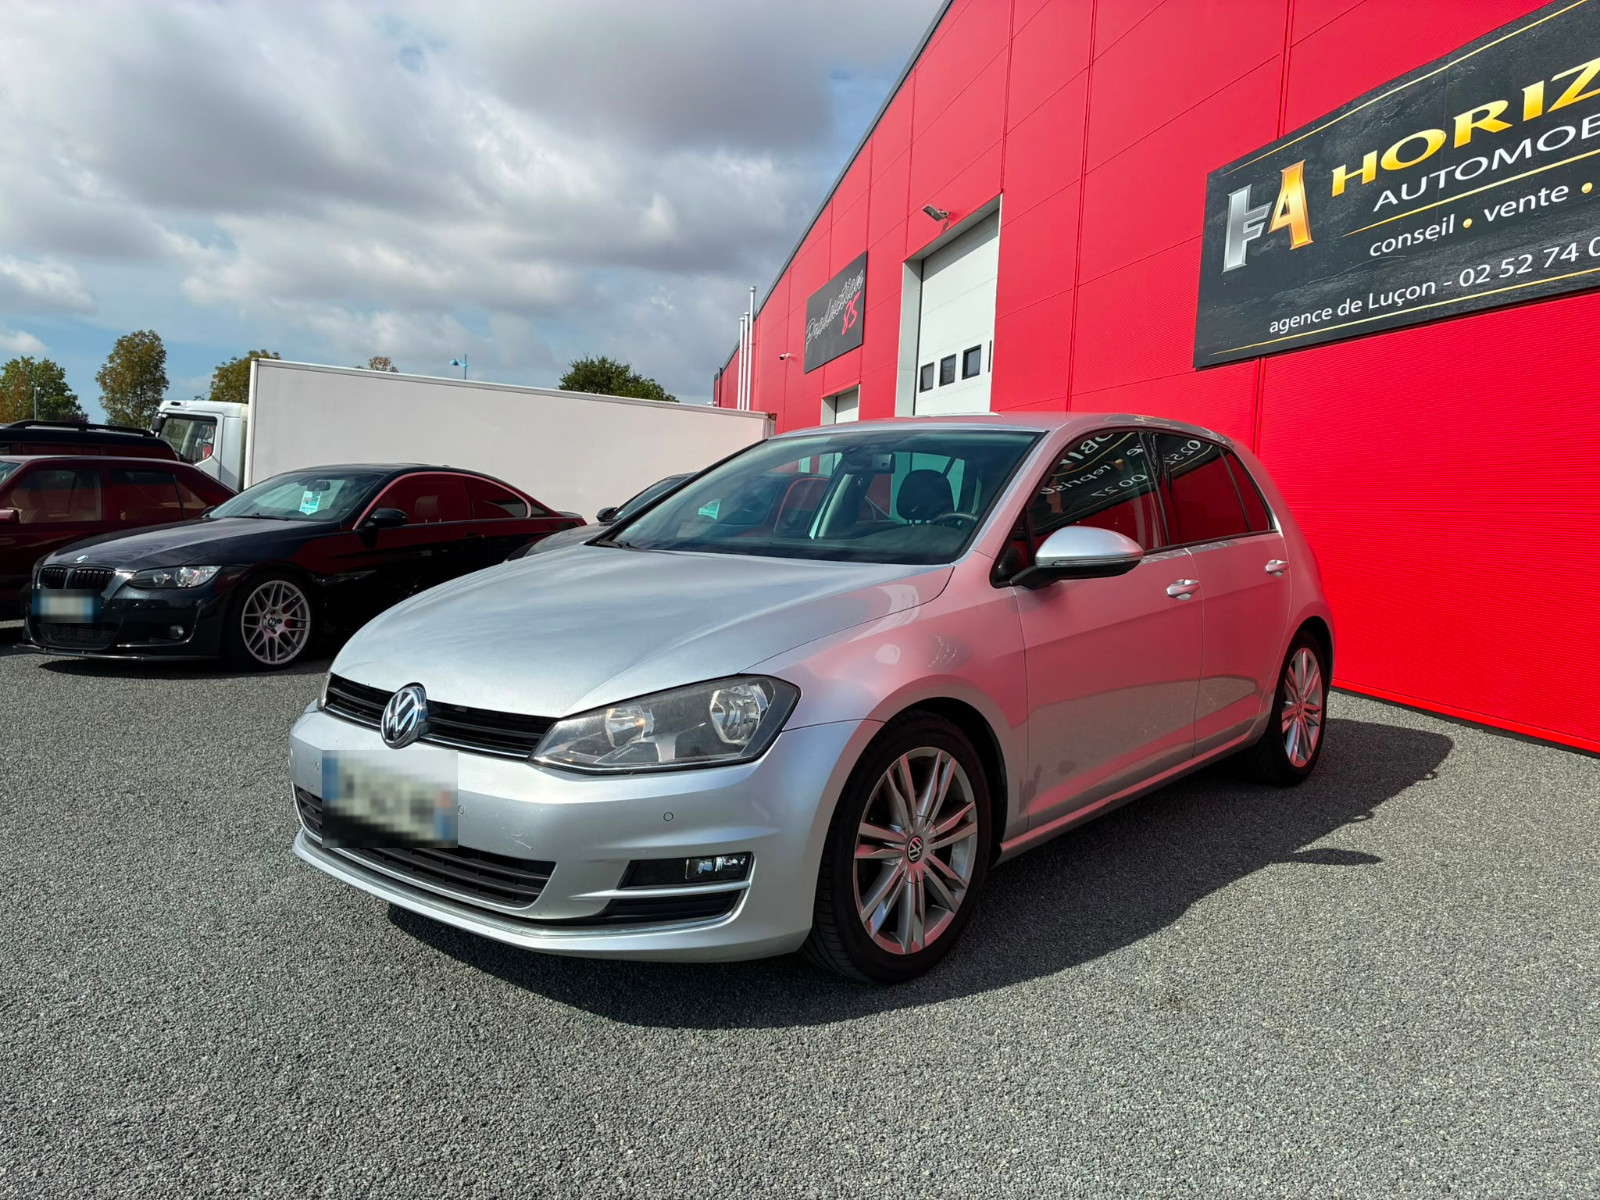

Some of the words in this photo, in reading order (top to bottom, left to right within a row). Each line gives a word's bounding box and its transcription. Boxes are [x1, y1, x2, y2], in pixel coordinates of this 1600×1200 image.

[1331, 57, 1600, 198] HORIZ
[1369, 213, 1455, 257] conseil
[1483, 185, 1570, 222] vente
[1269, 307, 1333, 335] agence
[1337, 298, 1363, 317] de
[1368, 281, 1436, 307] Luçon
[1459, 264, 1491, 287] 02
[1499, 254, 1533, 278] 52
[1543, 242, 1580, 269] 74
